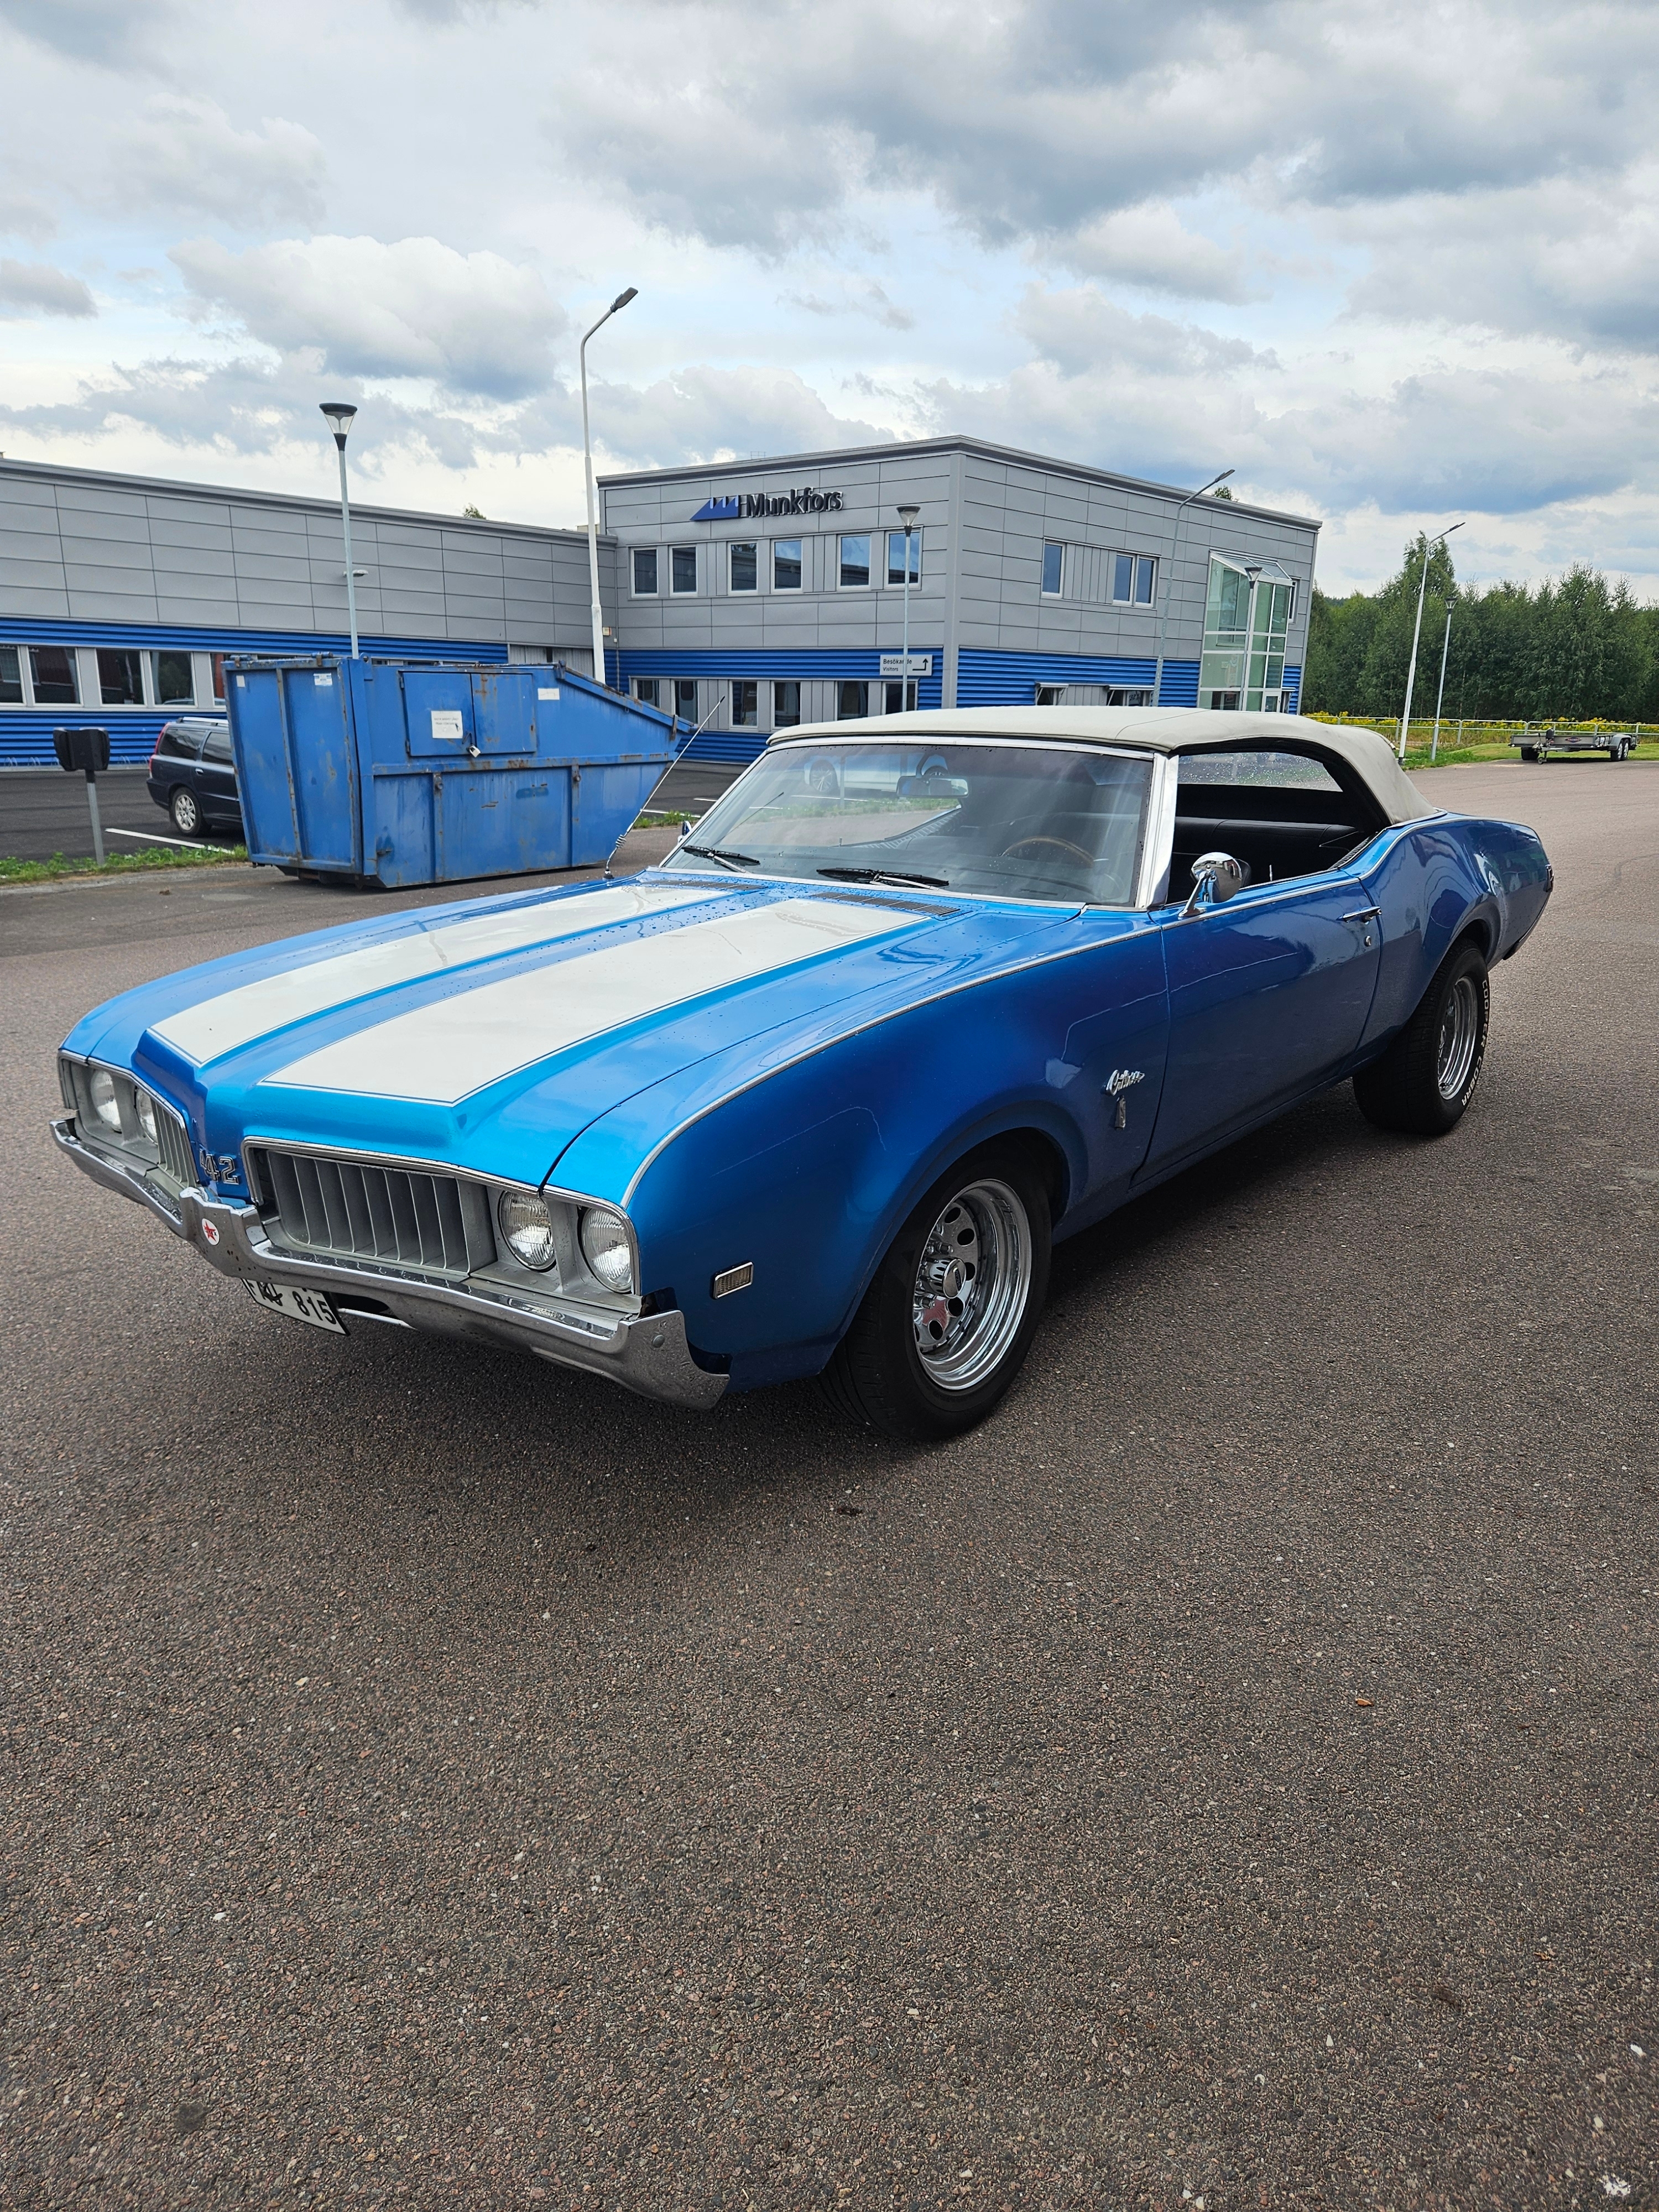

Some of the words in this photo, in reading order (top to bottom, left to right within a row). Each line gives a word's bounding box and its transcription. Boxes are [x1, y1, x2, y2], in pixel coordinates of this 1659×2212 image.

[747, 487, 843, 518] Munkfors
[1462, 1056, 1482, 1106] COBRA
[292, 1291, 337, 1324] 815
